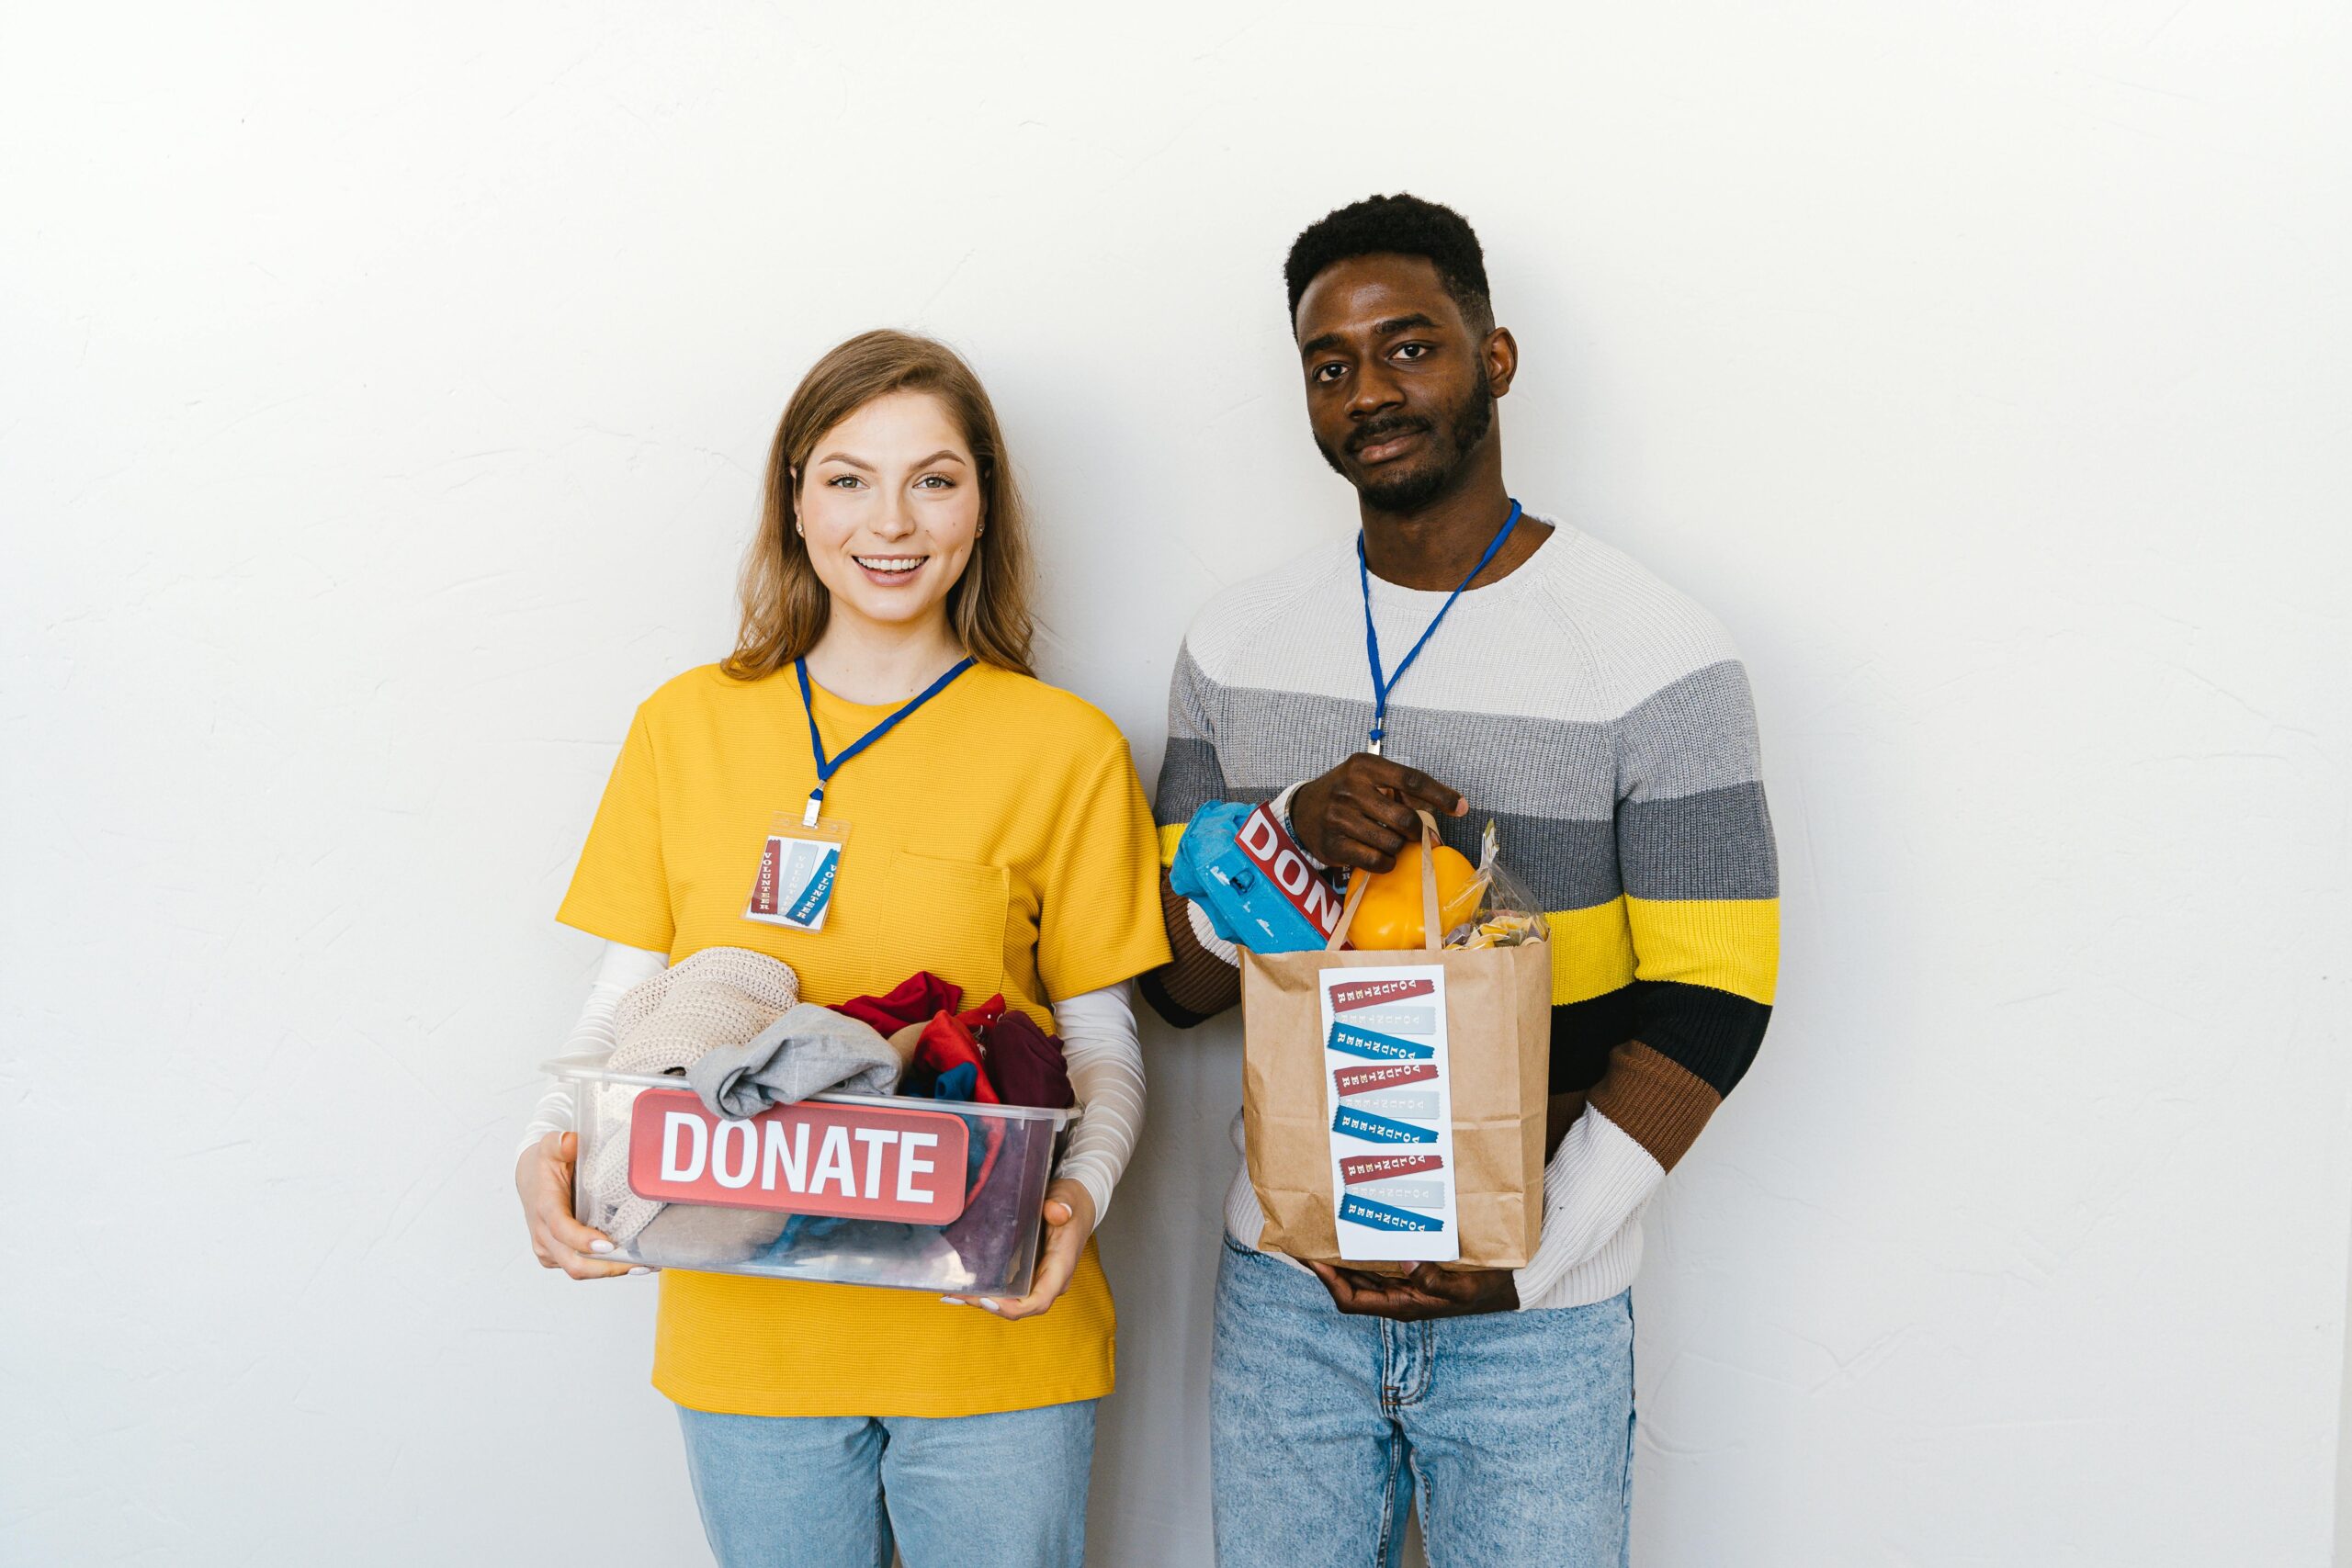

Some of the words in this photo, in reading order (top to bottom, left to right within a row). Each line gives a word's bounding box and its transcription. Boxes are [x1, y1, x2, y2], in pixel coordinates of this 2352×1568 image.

[759, 852, 773, 910] VOLUNTEER
[1239, 808, 1341, 935] DON
[796, 863, 837, 919] VOLUNTEER
[1338, 979, 1417, 1004] VOLUNTEER
[1337, 1032, 1416, 1060] VOLUNTEER
[1341, 1065, 1421, 1088] VOLUNTEER
[1341, 1115, 1420, 1144] VOLUNTEER
[661, 1111, 938, 1204] DONATE
[1347, 1155, 1426, 1177] VOLUNTEER
[1348, 1202, 1426, 1232] VOLUNTEER
